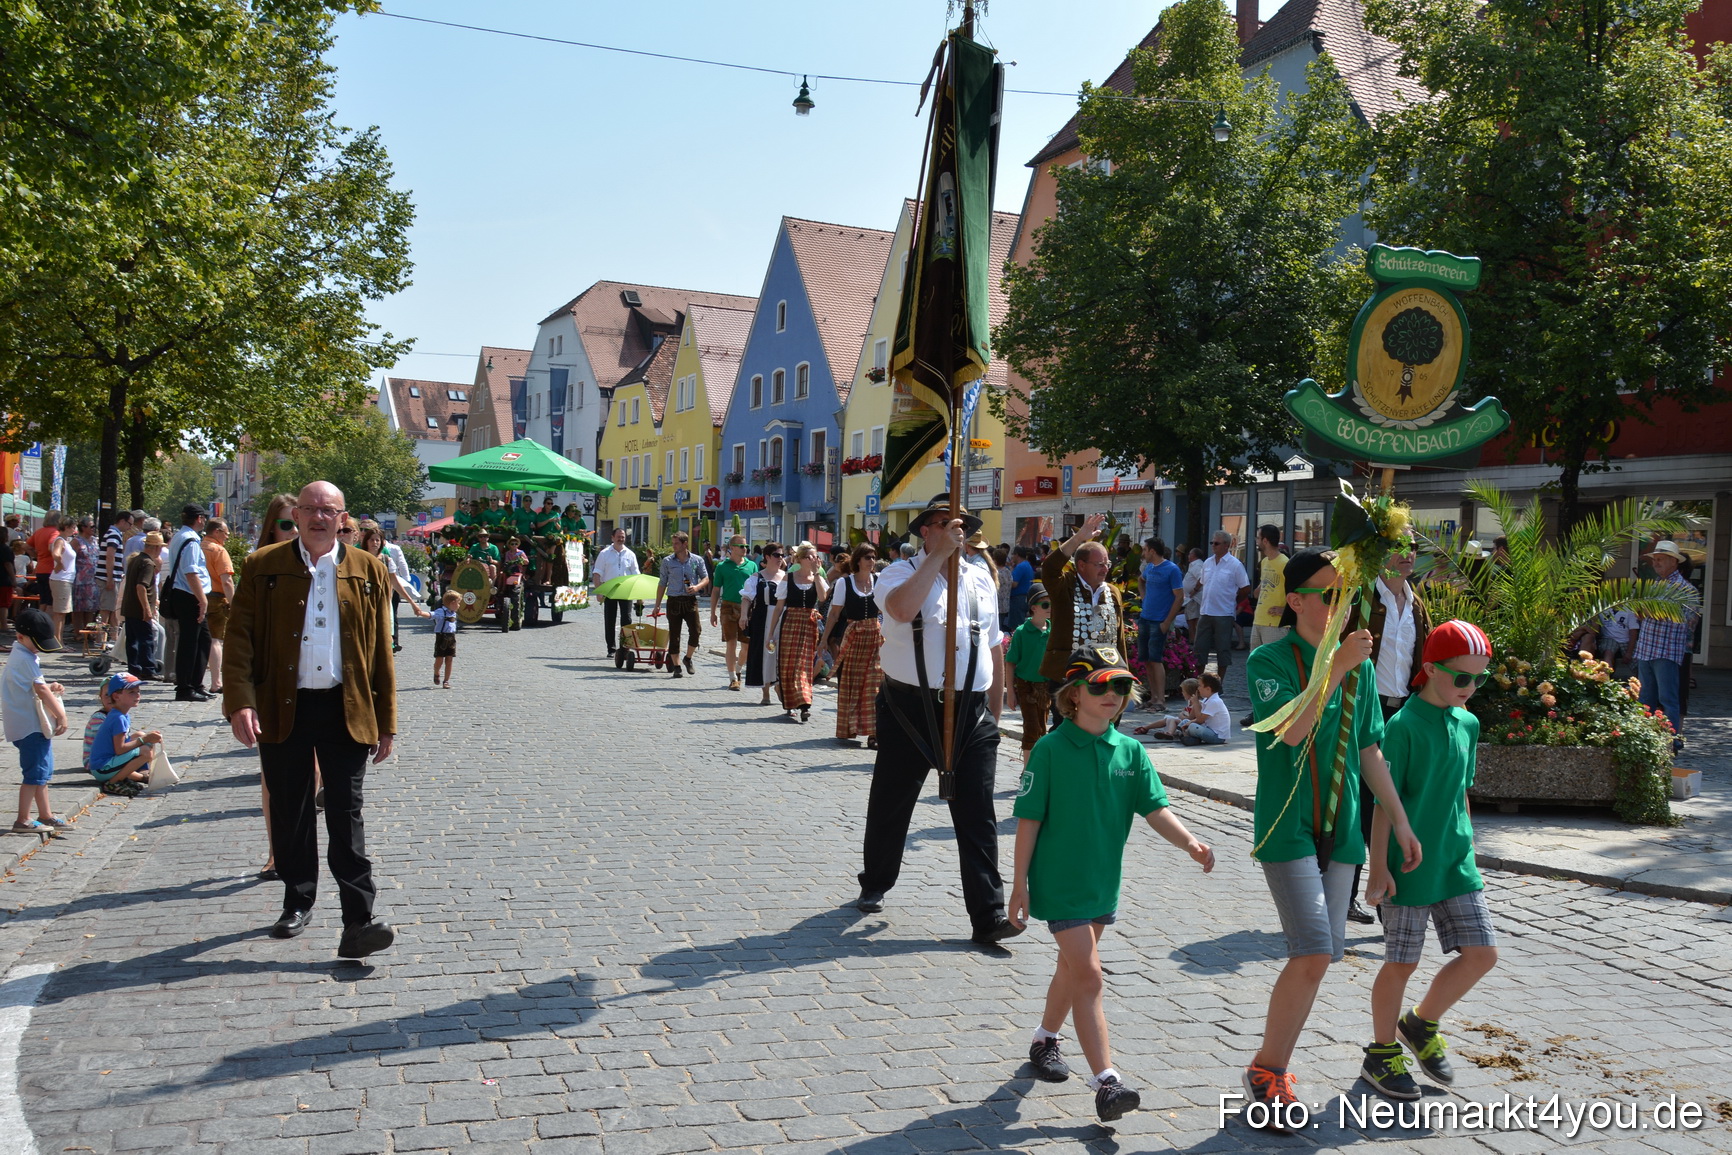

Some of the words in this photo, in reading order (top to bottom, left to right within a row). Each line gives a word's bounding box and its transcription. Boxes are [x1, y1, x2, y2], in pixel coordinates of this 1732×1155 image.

[1378, 252, 1470, 281] Schützenverein
[1393, 293, 1449, 317] WOFFENBACH
[1410, 403, 1430, 416] ALTE
[1429, 383, 1449, 406] LINDE
[624, 439, 639, 453] HOTEL
[1039, 480, 1053, 489] DER
[729, 496, 767, 513] APOTHEKE
